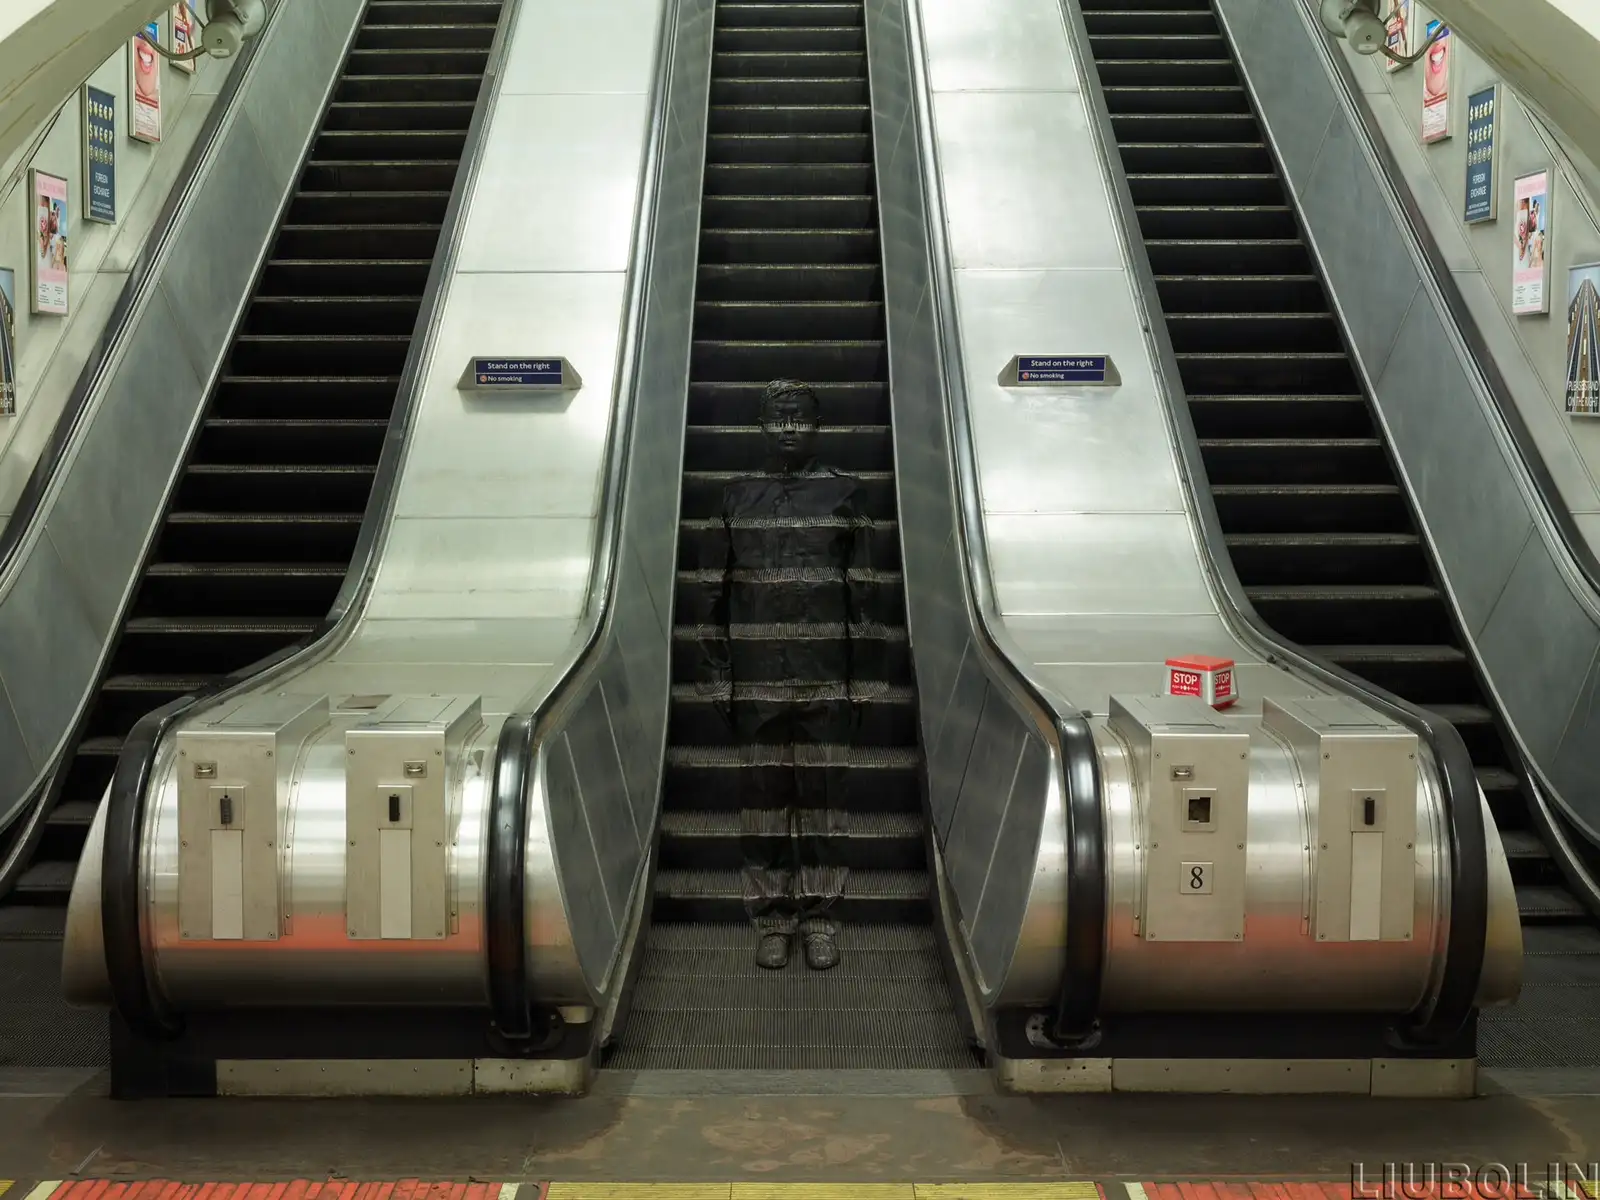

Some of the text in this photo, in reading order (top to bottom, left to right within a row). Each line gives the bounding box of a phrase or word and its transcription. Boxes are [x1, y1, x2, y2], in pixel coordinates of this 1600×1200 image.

[95, 171, 109, 184] FOREIGN
[1472, 172, 1486, 184] FOREIGN
[93, 185, 110, 198] EXCHANGE
[1470, 185, 1487, 198] EXCHANGE
[1567, 396, 1576, 407] ON
[1584, 396, 1599, 407] RIGHT
[1173, 672, 1198, 685] STOP
[1215, 673, 1229, 684] STOP
[1190, 866, 1203, 889] 8
